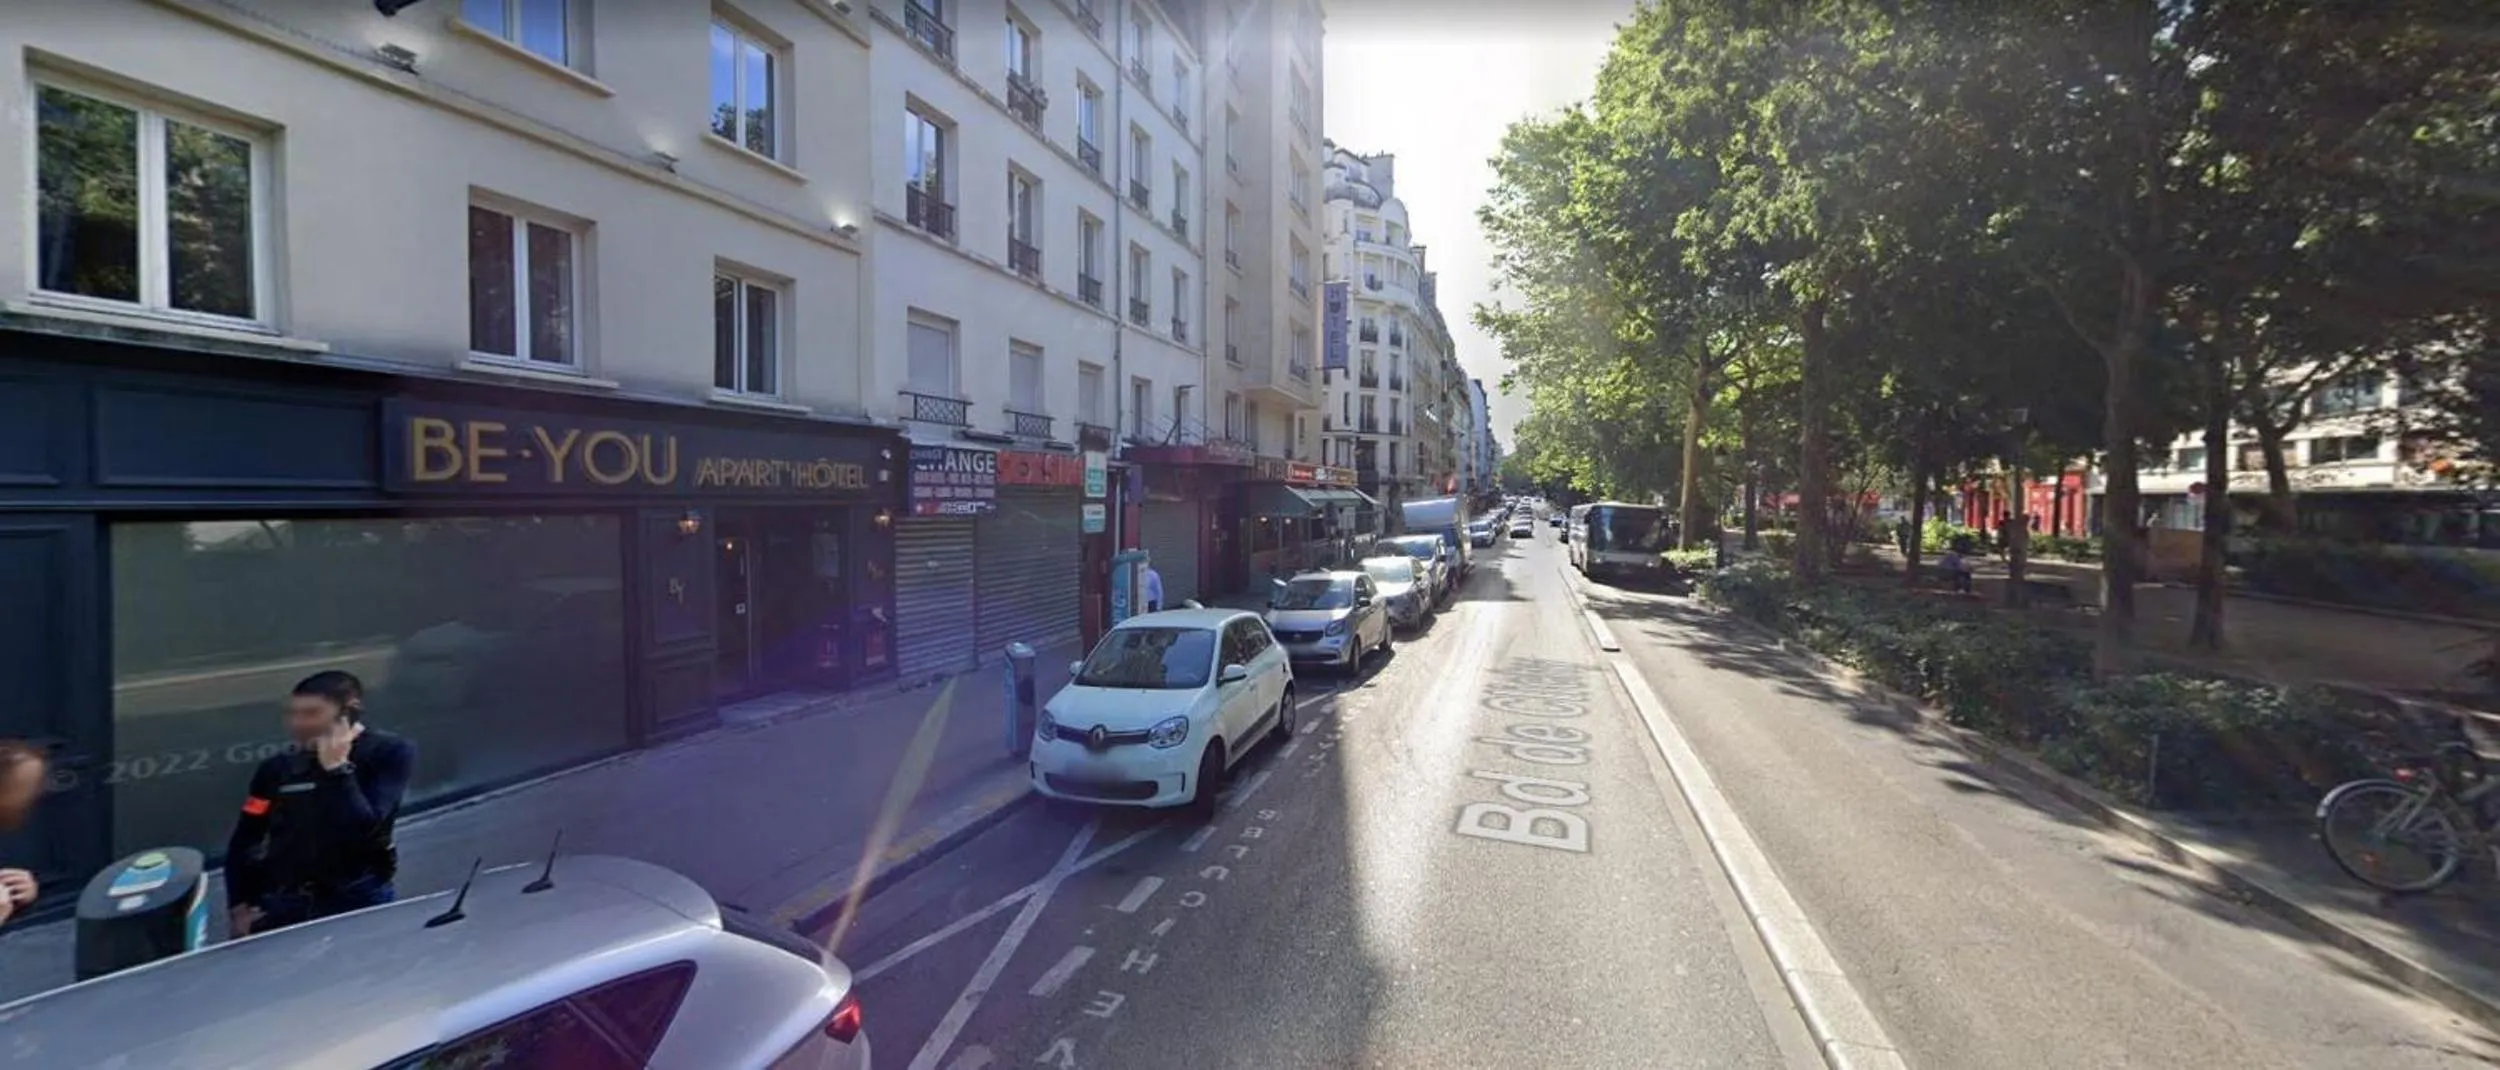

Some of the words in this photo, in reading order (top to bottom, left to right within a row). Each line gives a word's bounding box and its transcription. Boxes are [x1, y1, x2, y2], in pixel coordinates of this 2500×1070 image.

[410, 417, 509, 483] BE
[534, 426, 679, 486] YOU
[916, 450, 996, 474] ANGE
